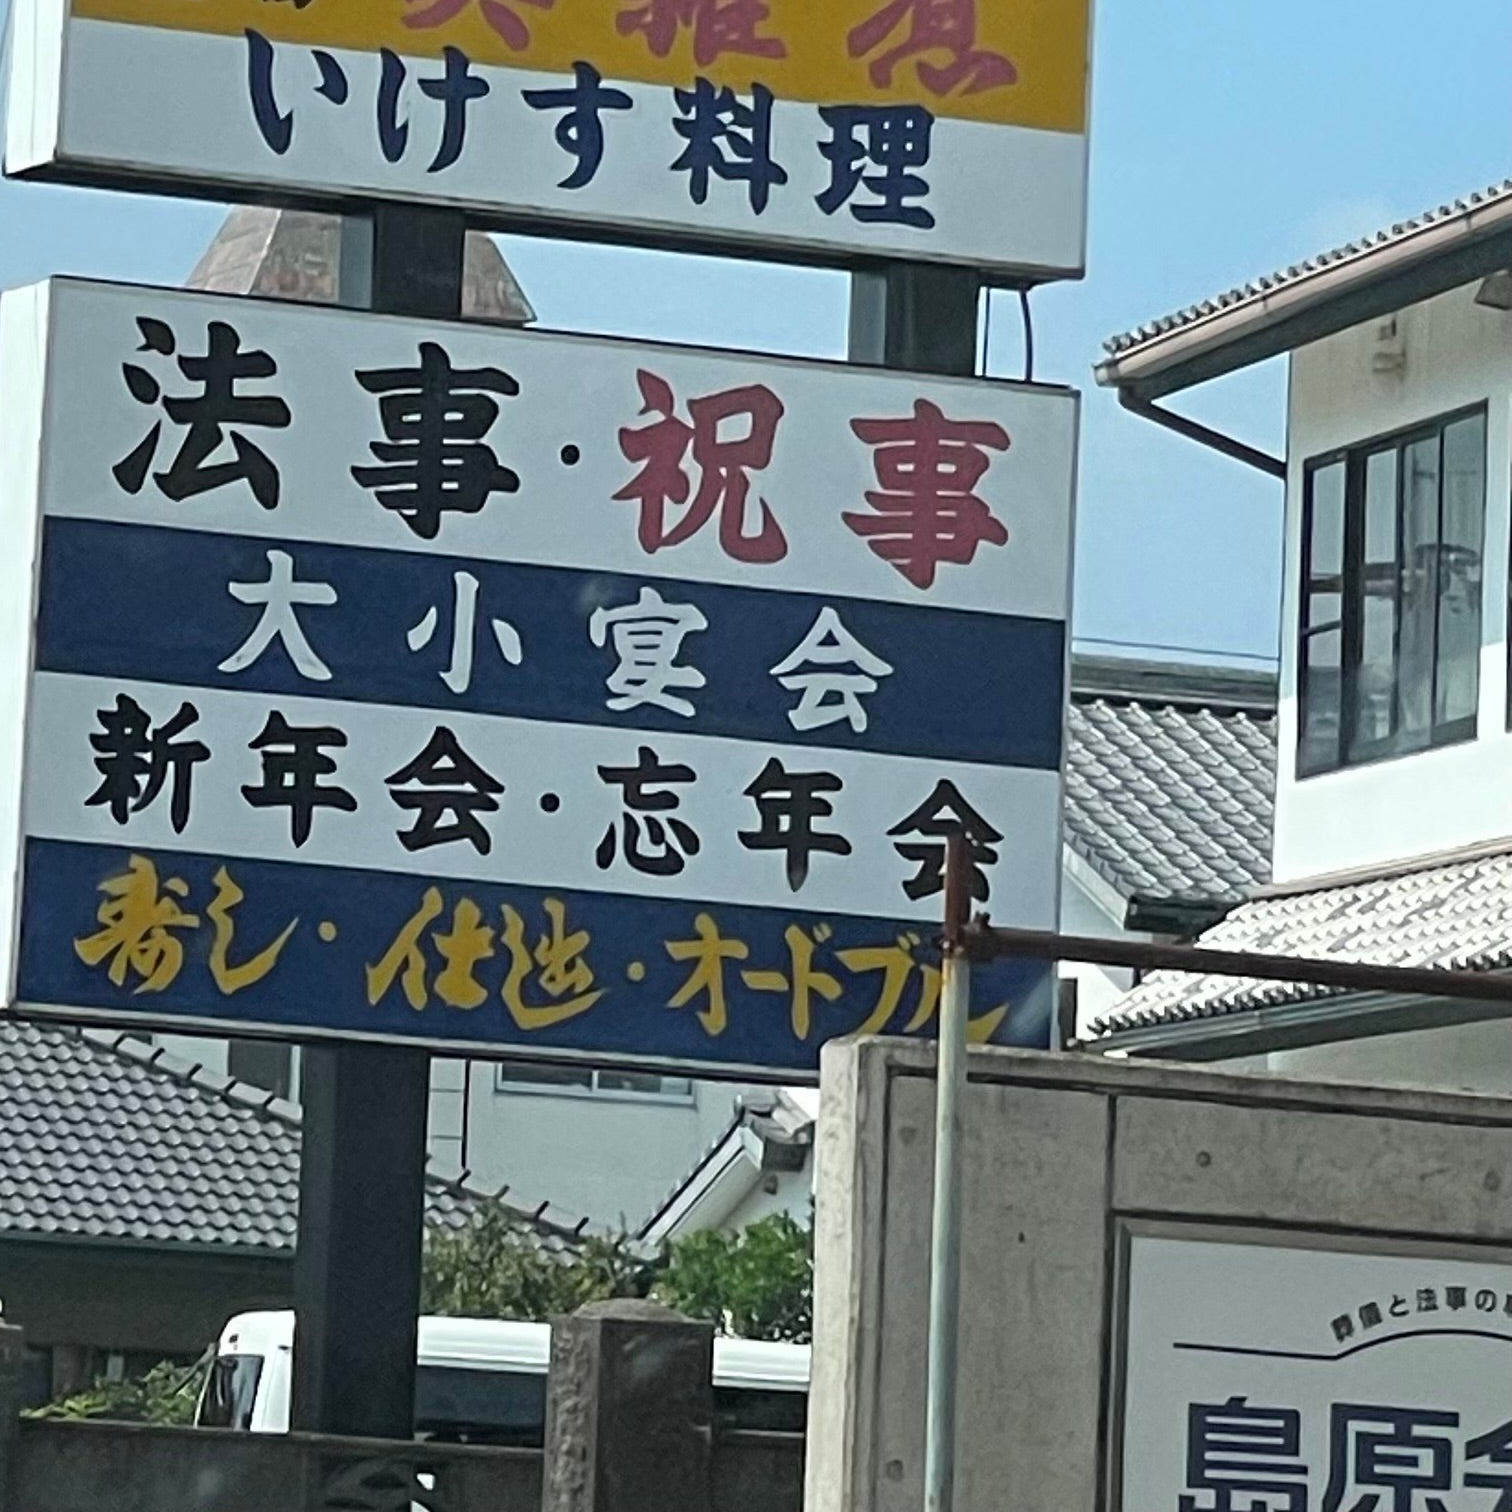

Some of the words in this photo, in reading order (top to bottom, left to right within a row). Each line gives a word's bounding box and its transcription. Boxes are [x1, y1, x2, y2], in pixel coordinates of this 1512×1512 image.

[245, 29, 935, 230] いけす料理
[218, 551, 895, 733] 大小宴会
